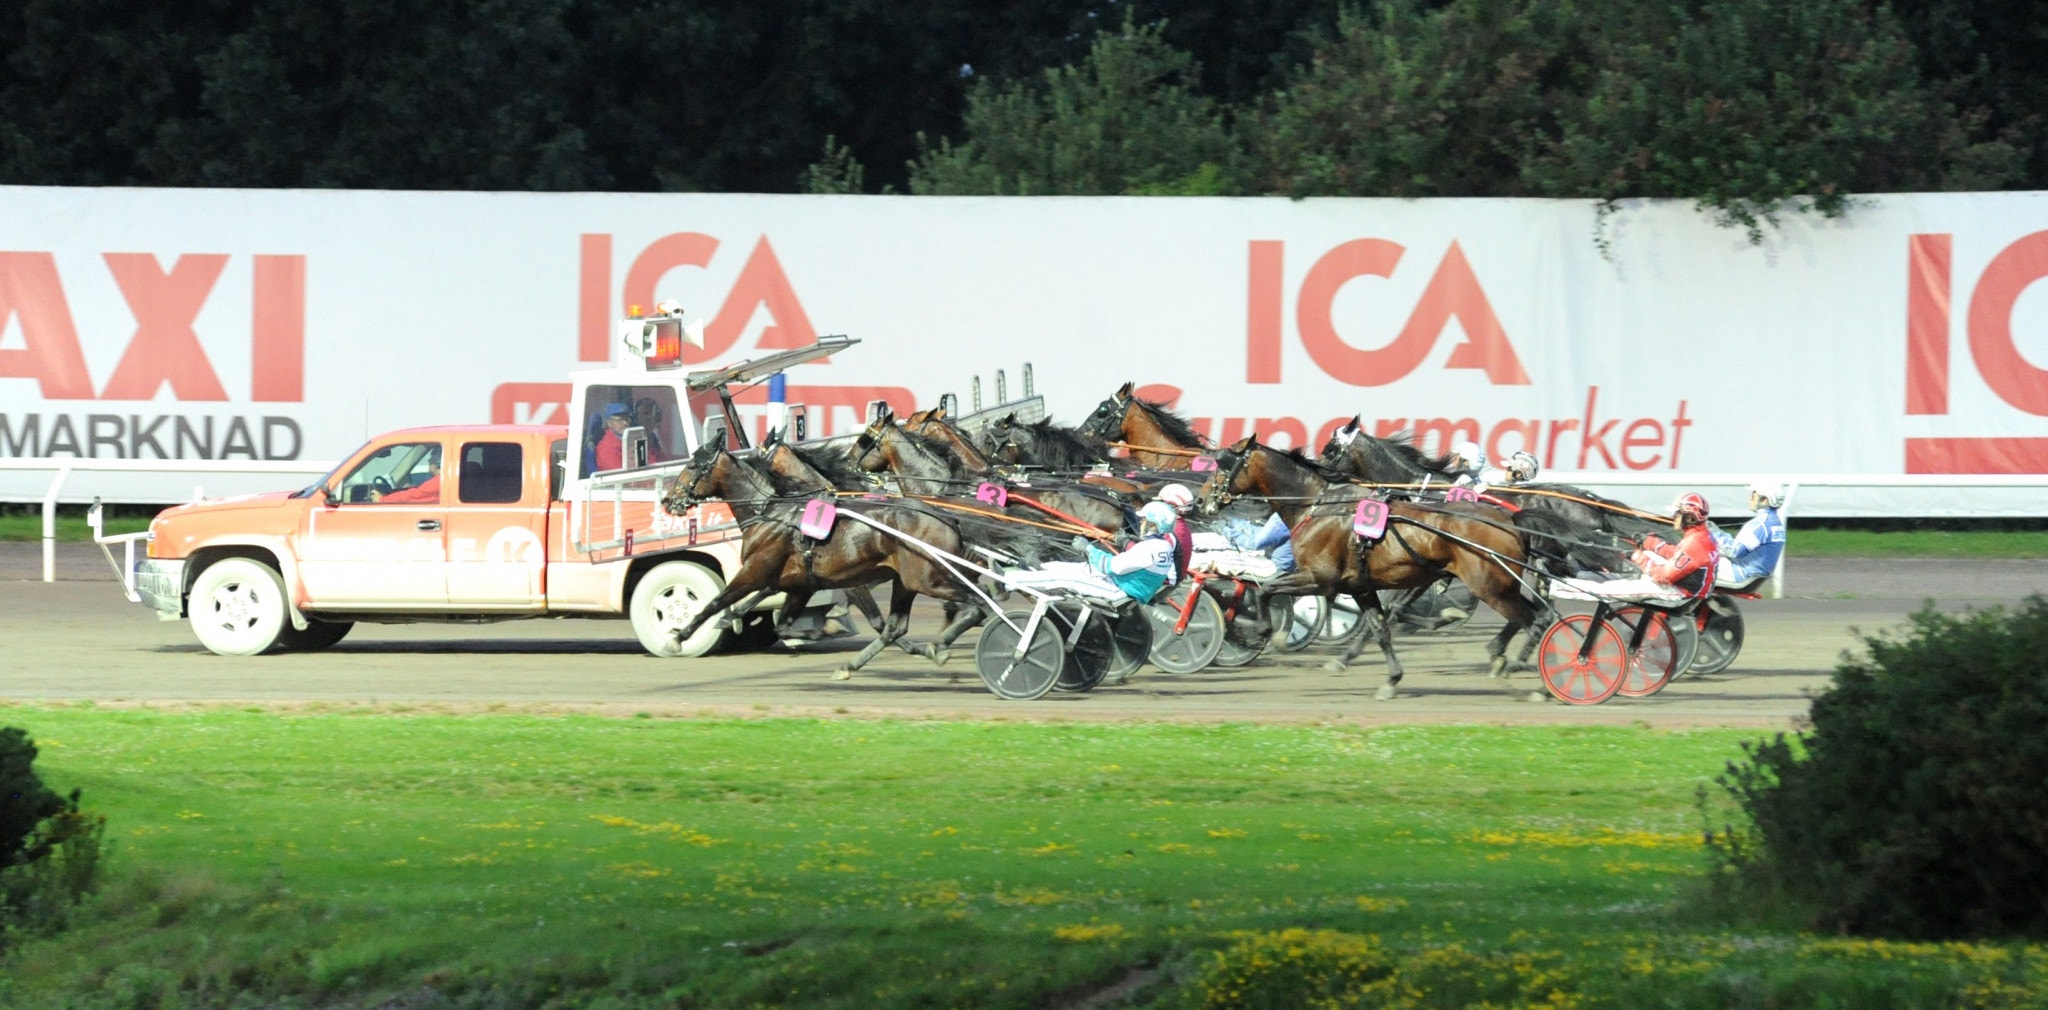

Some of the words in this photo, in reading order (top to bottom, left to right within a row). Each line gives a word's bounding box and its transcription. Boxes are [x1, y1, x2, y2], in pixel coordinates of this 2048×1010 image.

[577, 231, 831, 365] ICA
[1246, 237, 1532, 388] ICA
[0, 412, 304, 461] MARKNAD
[797, 418, 805, 437] 3
[1198, 458, 1215, 472] 7
[813, 503, 826, 527] 1
[1363, 502, 1380, 528] 9
